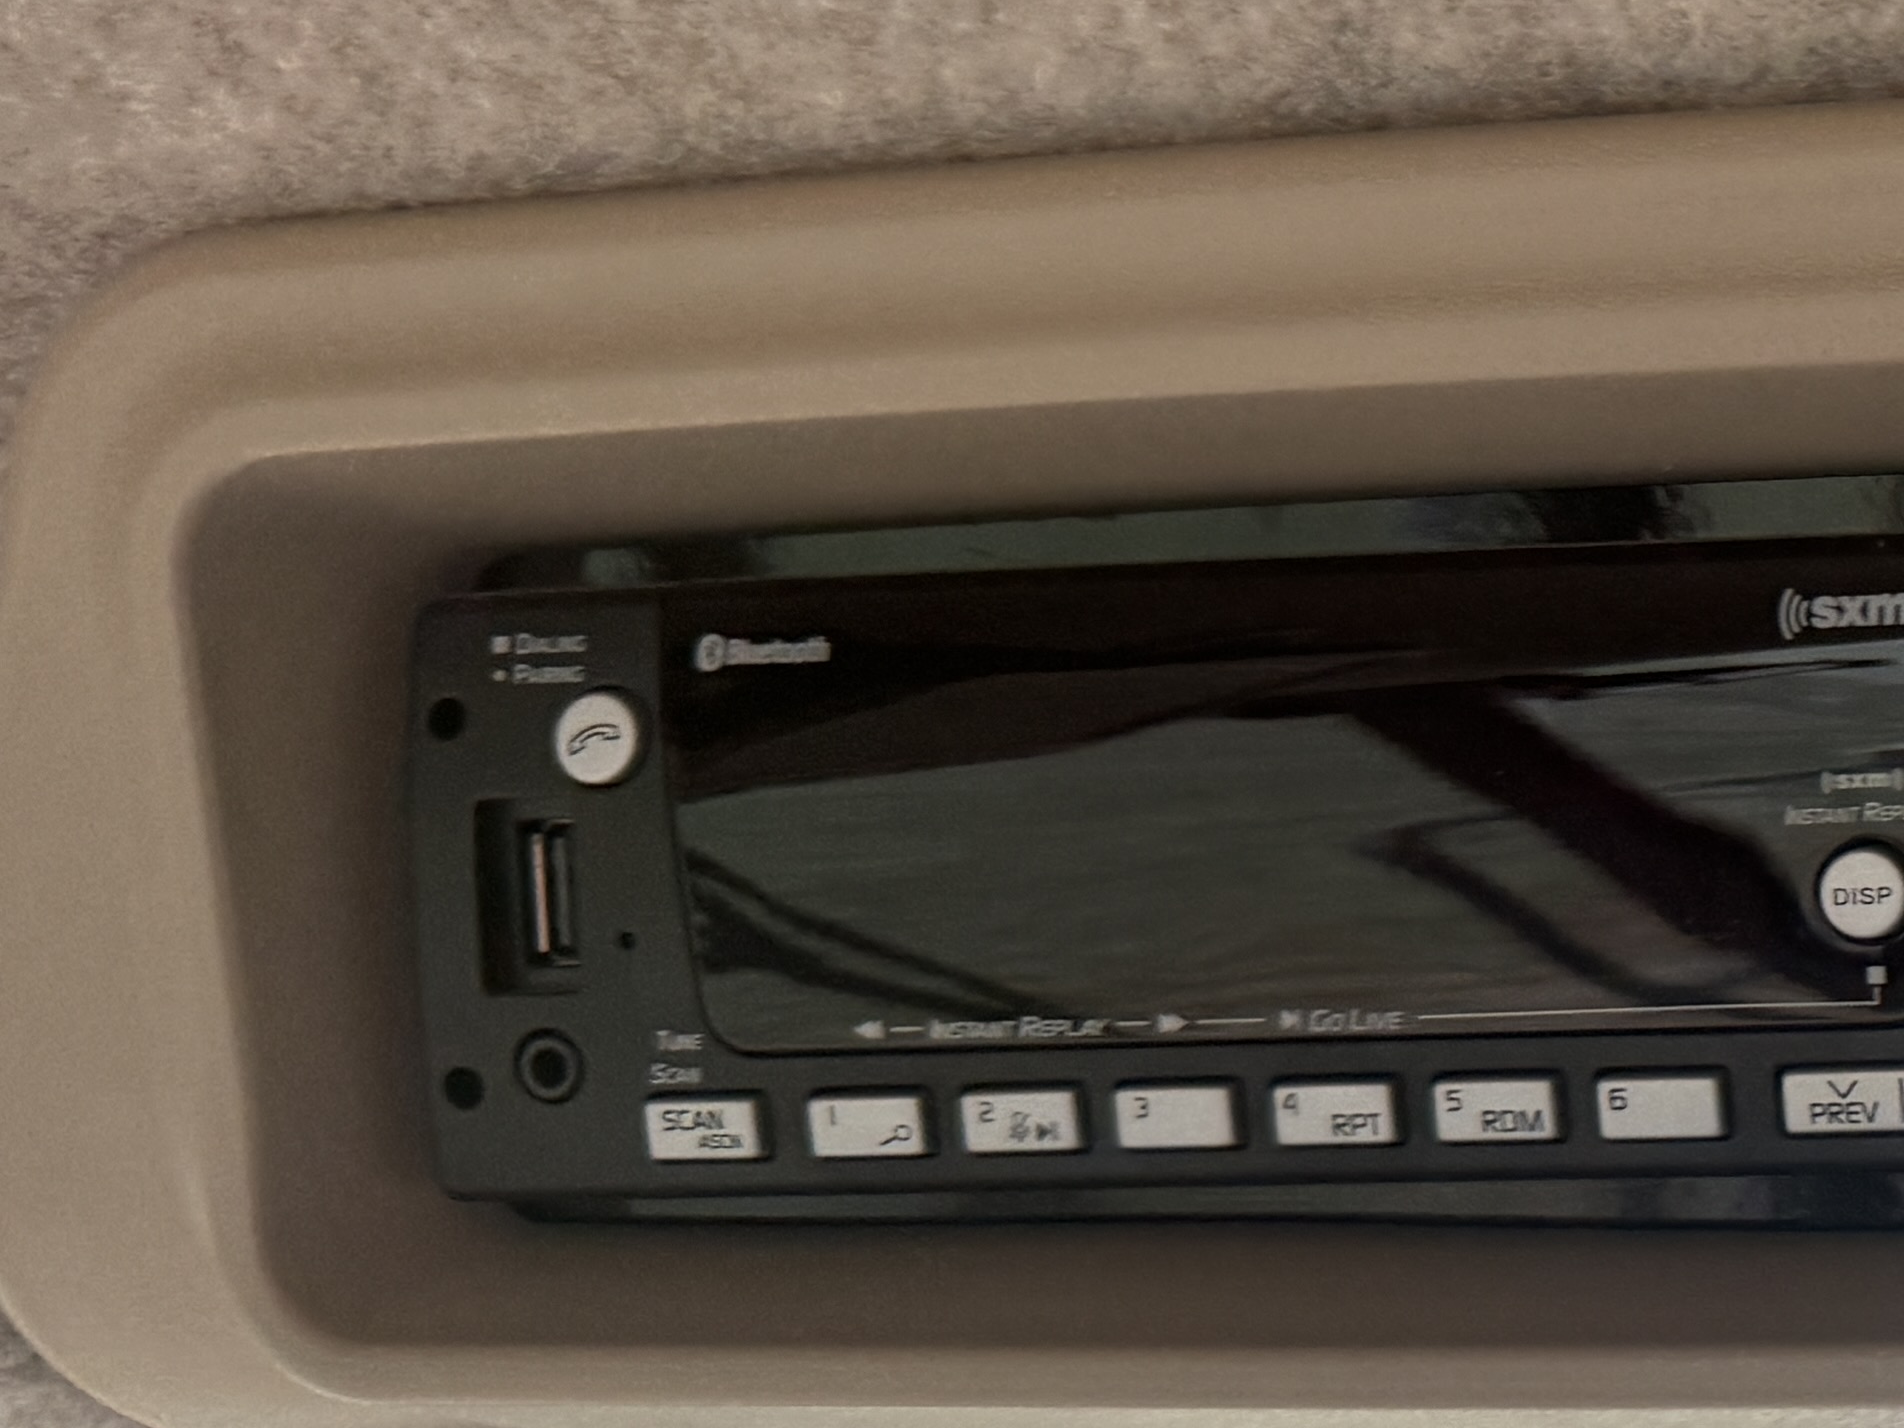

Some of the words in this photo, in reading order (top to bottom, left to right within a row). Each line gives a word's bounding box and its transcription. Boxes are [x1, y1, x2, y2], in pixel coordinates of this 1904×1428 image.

[1832, 886, 1893, 908] DISP
[979, 1100, 996, 1124] 2
[1133, 1096, 1151, 1120] 3
[1281, 1091, 1299, 1116] 4
[1445, 1088, 1464, 1113] 5
[1608, 1087, 1629, 1112] 6
[661, 1108, 725, 1132] SCAN
[828, 1104, 837, 1126] 1
[1331, 1112, 1382, 1138] RPT
[1480, 1109, 1546, 1134] RDM
[1809, 1100, 1880, 1125] PREV
